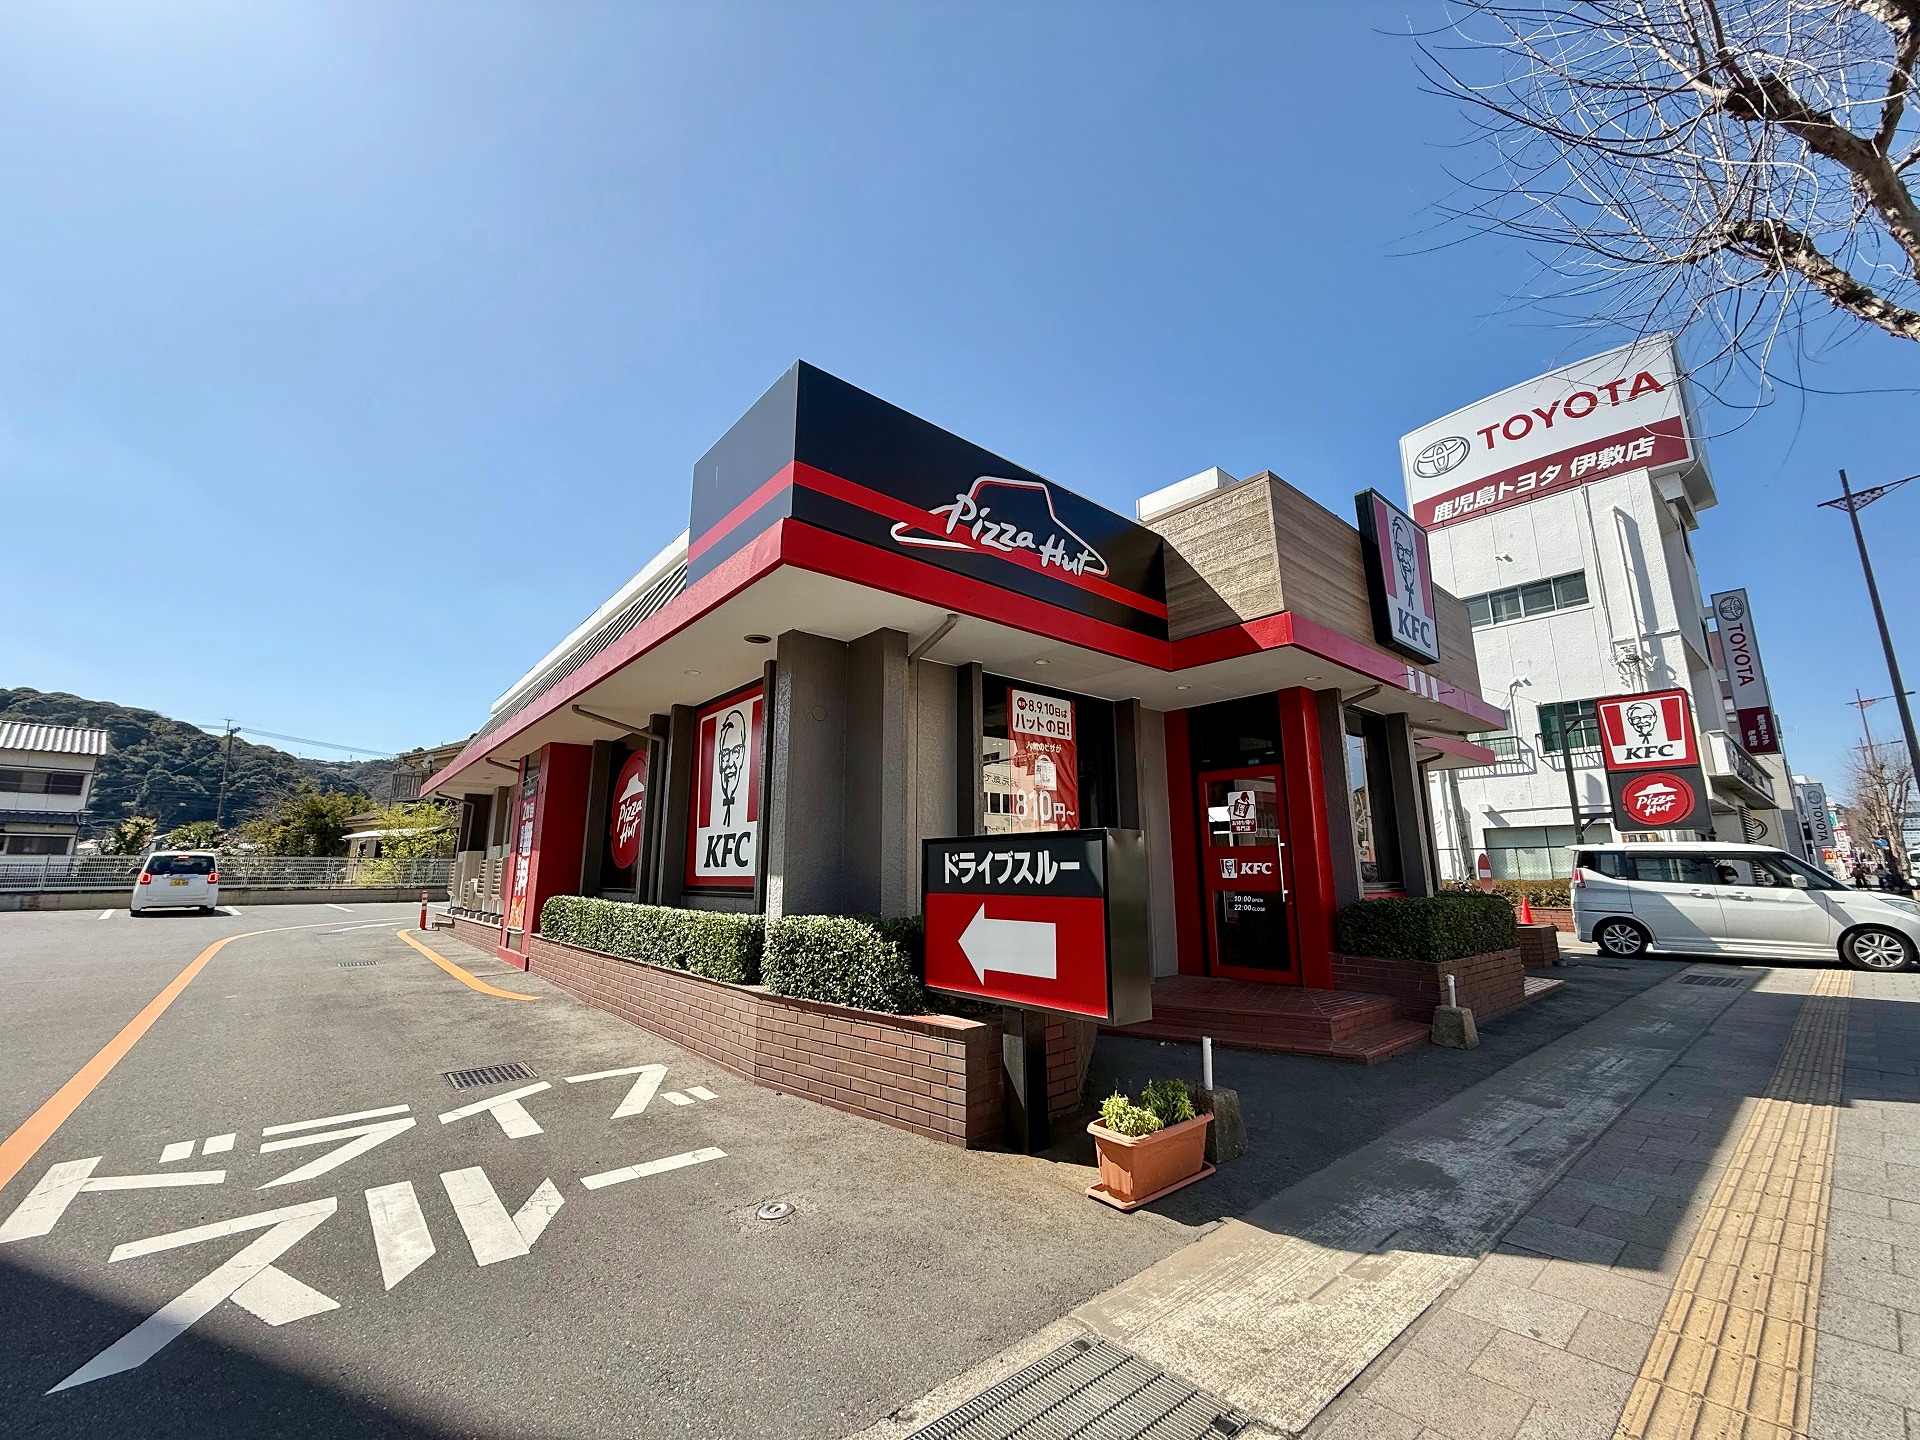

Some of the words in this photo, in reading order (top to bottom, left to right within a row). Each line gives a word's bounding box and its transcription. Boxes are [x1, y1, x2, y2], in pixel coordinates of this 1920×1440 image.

[1477, 371, 1665, 450] TOYOTA
[1432, 463, 1563, 524] 鹿児島トヨタ
[1569, 435, 1656, 478] 伊敷店
[945, 493, 1037, 552] Pizza
[1039, 533, 1096, 577] Hut
[1397, 606, 1432, 649] KFC
[1727, 622, 1755, 687] TOYOTA
[1028, 699, 1068, 718] 8.9.10日は
[1624, 744, 1675, 761] KFC
[617, 798, 642, 833] Pizza
[1636, 794, 1677, 810] Pizza
[1644, 801, 1676, 817] Hut
[619, 818, 641, 849] Hut
[1811, 806, 1828, 841] TOYOTA
[703, 831, 751, 868] KFC
[944, 850, 1080, 885] ドライブスルー
[1240, 862, 1272, 874] KFC
[0, 1064, 720, 1243] ドライブ
[46, 1147, 729, 1395] スルー
